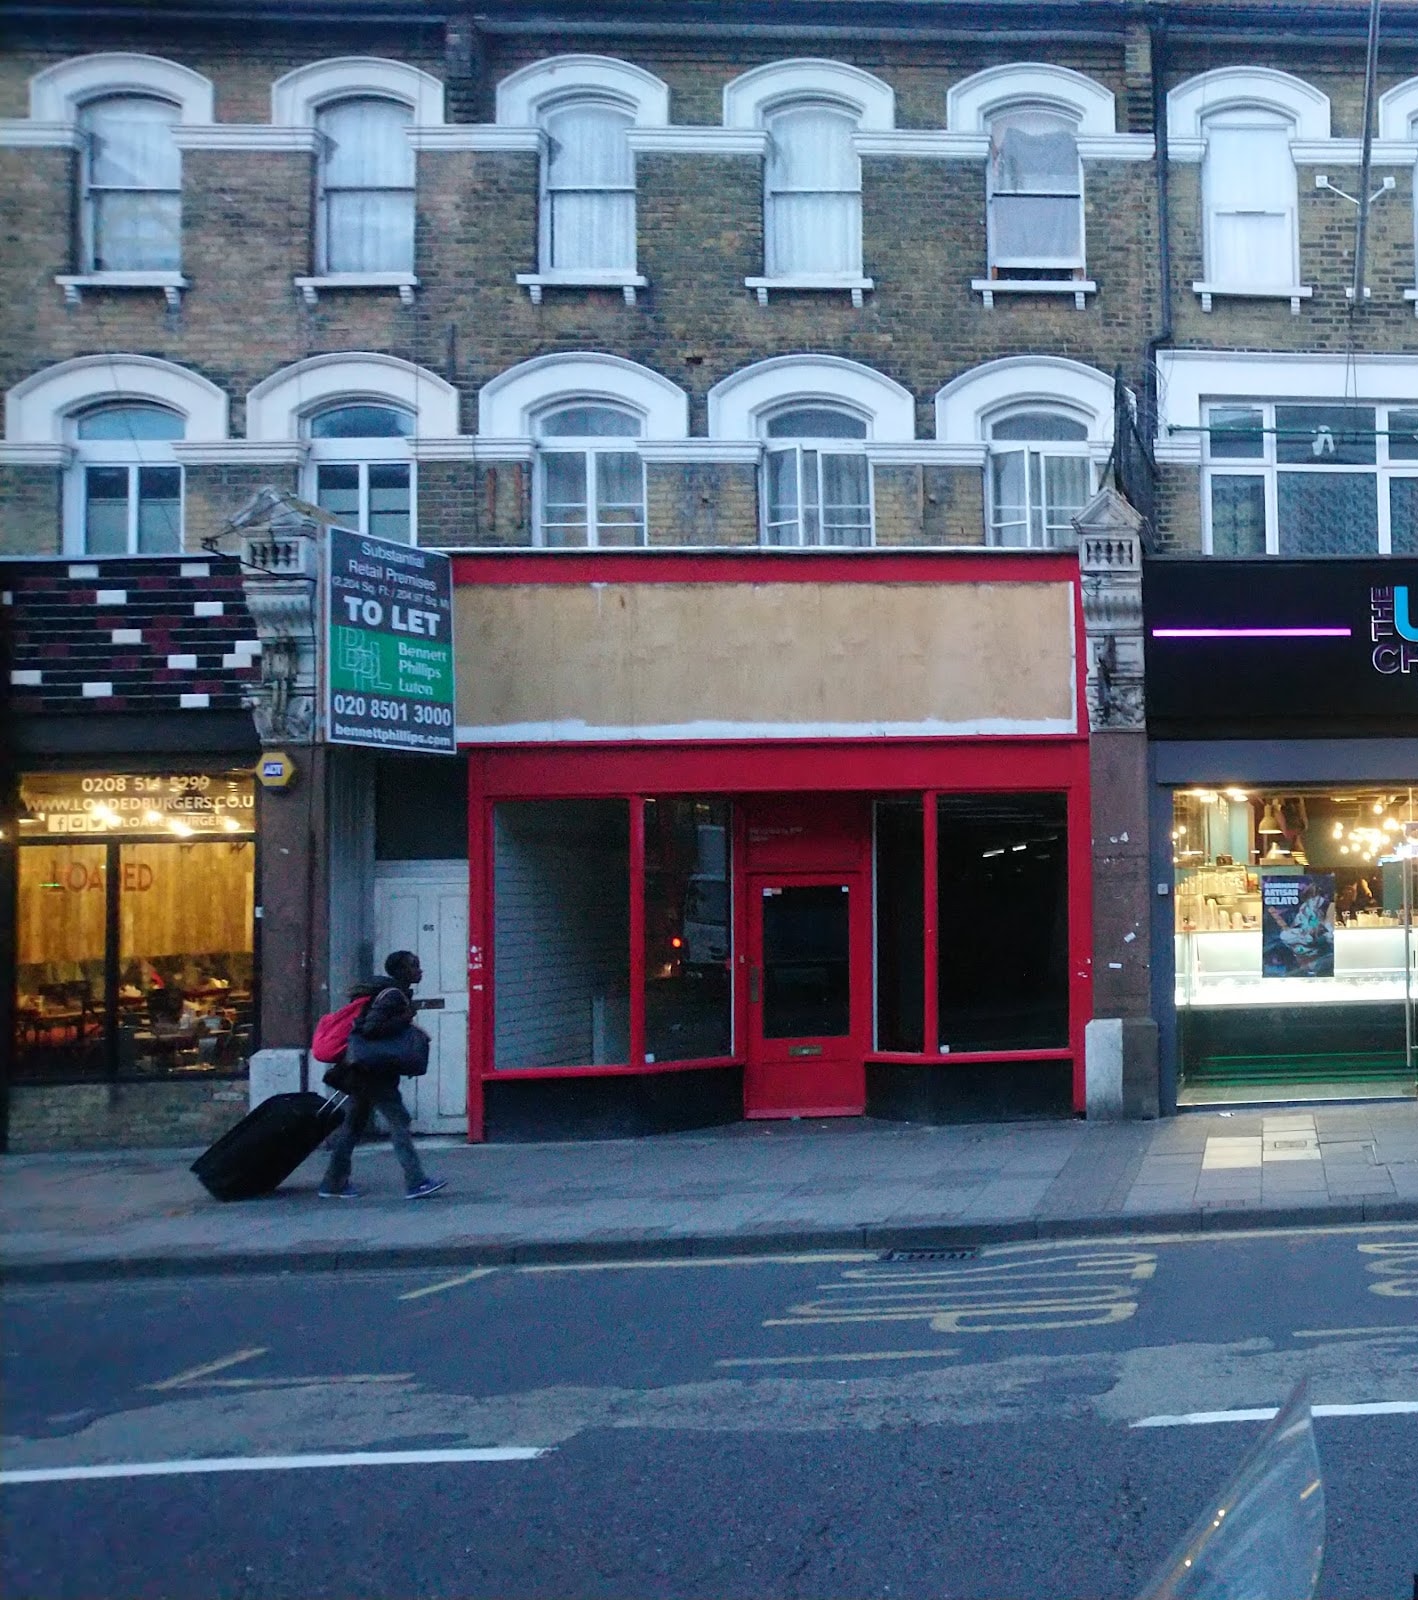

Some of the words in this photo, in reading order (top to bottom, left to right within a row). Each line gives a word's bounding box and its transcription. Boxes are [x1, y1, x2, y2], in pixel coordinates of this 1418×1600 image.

[361, 542, 425, 568] Substantial
[348, 559, 384, 579] Retail
[385, 567, 438, 592] Premises
[344, 595, 384, 626] TO
[391, 604, 441, 636] LET
[1371, 586, 1393, 642] THE
[399, 642, 447, 662] Bennett
[399, 660, 442, 680] Phillips
[399, 678, 434, 695] Luton
[334, 694, 367, 717] 020
[370, 699, 408, 721] 8501
[413, 704, 452, 727] 3000
[335, 722, 452, 747] bennettphillips.com
[81, 777, 127, 793] 0208
[169, 775, 210, 792] 5299
[48, 861, 153, 893] LOAED
[1263, 889, 1299, 897] ARTISAN
[1263, 897, 1300, 905] GELATO
[762, 1252, 1158, 1333] STOP
